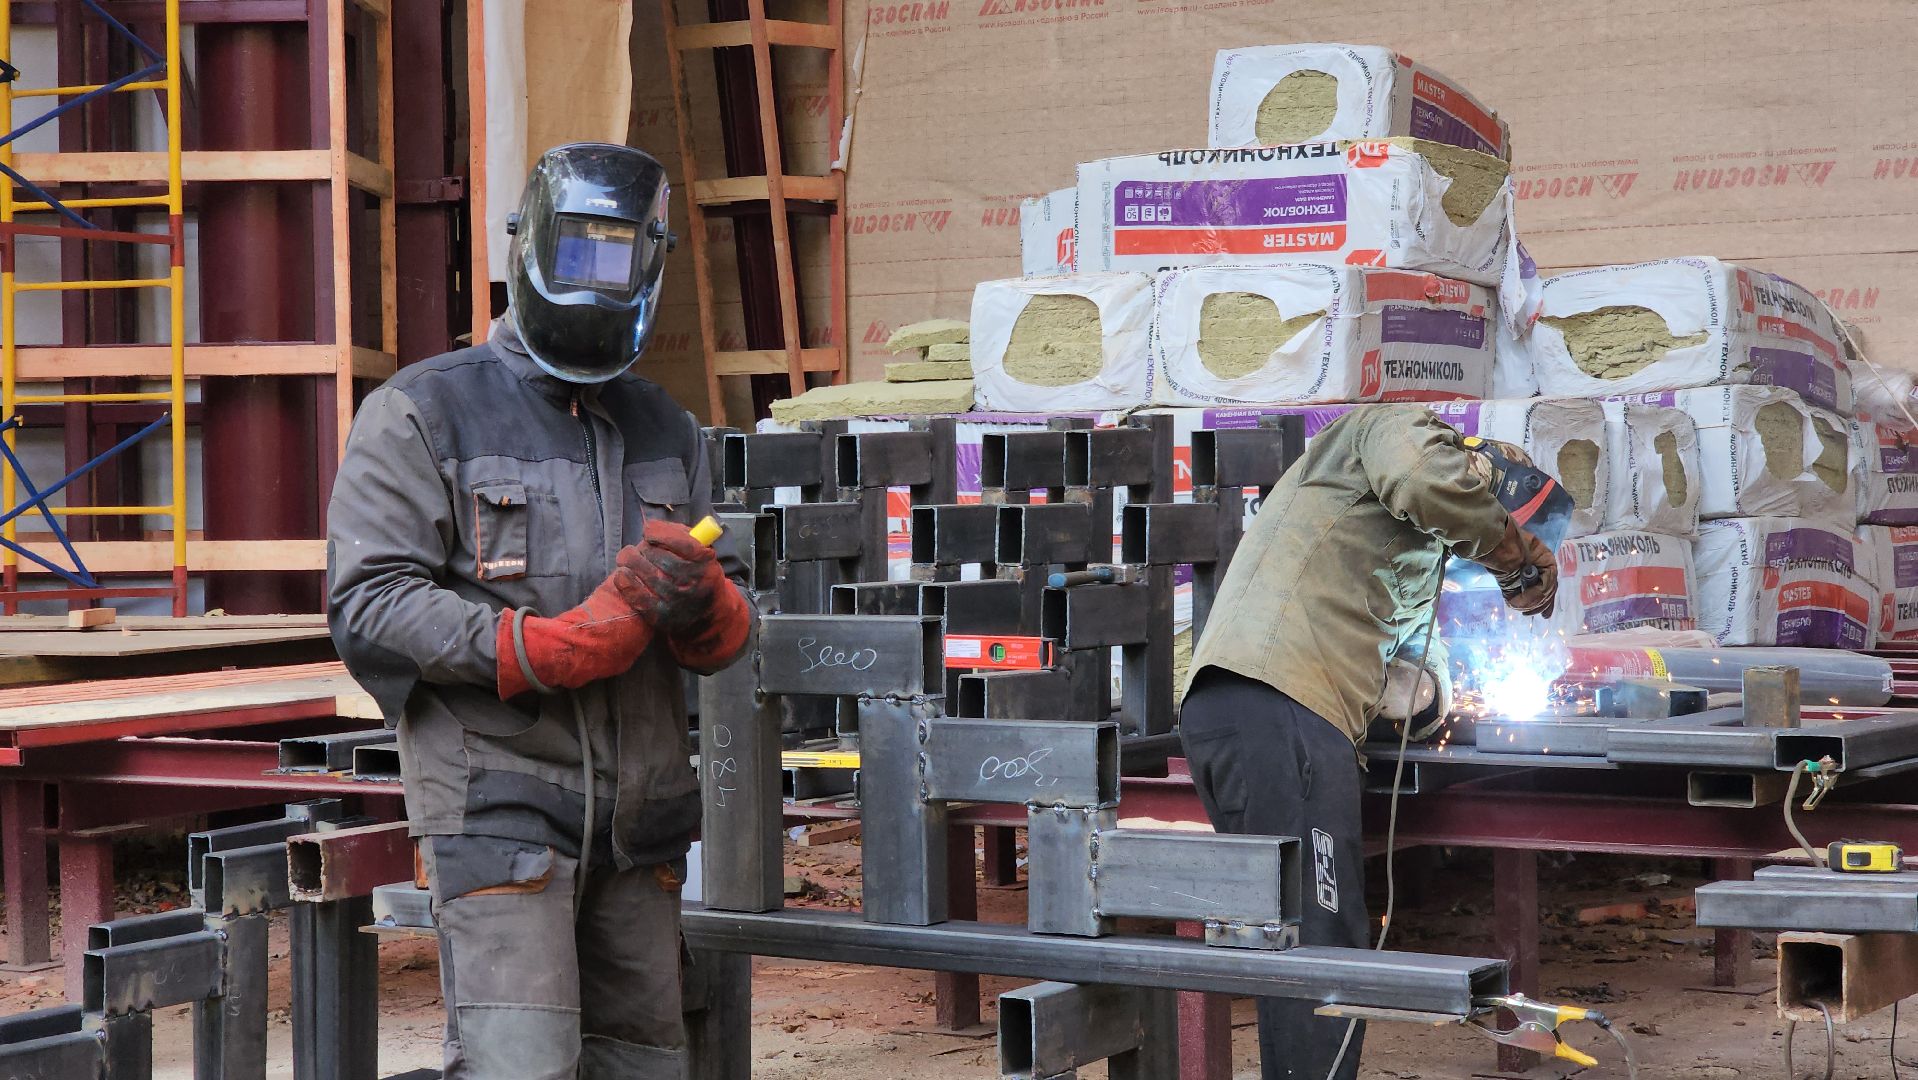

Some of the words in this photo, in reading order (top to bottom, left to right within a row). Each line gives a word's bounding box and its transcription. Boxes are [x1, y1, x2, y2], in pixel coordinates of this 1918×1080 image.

[1417, 79, 1446, 101] MASTER
[1673, 164, 1790, 191] ИЗОСПАН
[1515, 176, 1594, 201] ИЗОСП
[1263, 203, 1335, 218] ТЕХНОБЛОК
[846, 213, 917, 234] ИЗОСП
[1263, 231, 1335, 248] MASTER
[1438, 284, 1465, 298] MASTE
[1384, 360, 1465, 381] ТЕХНОНИКОЛЬ
[711, 724, 737, 807] 480
